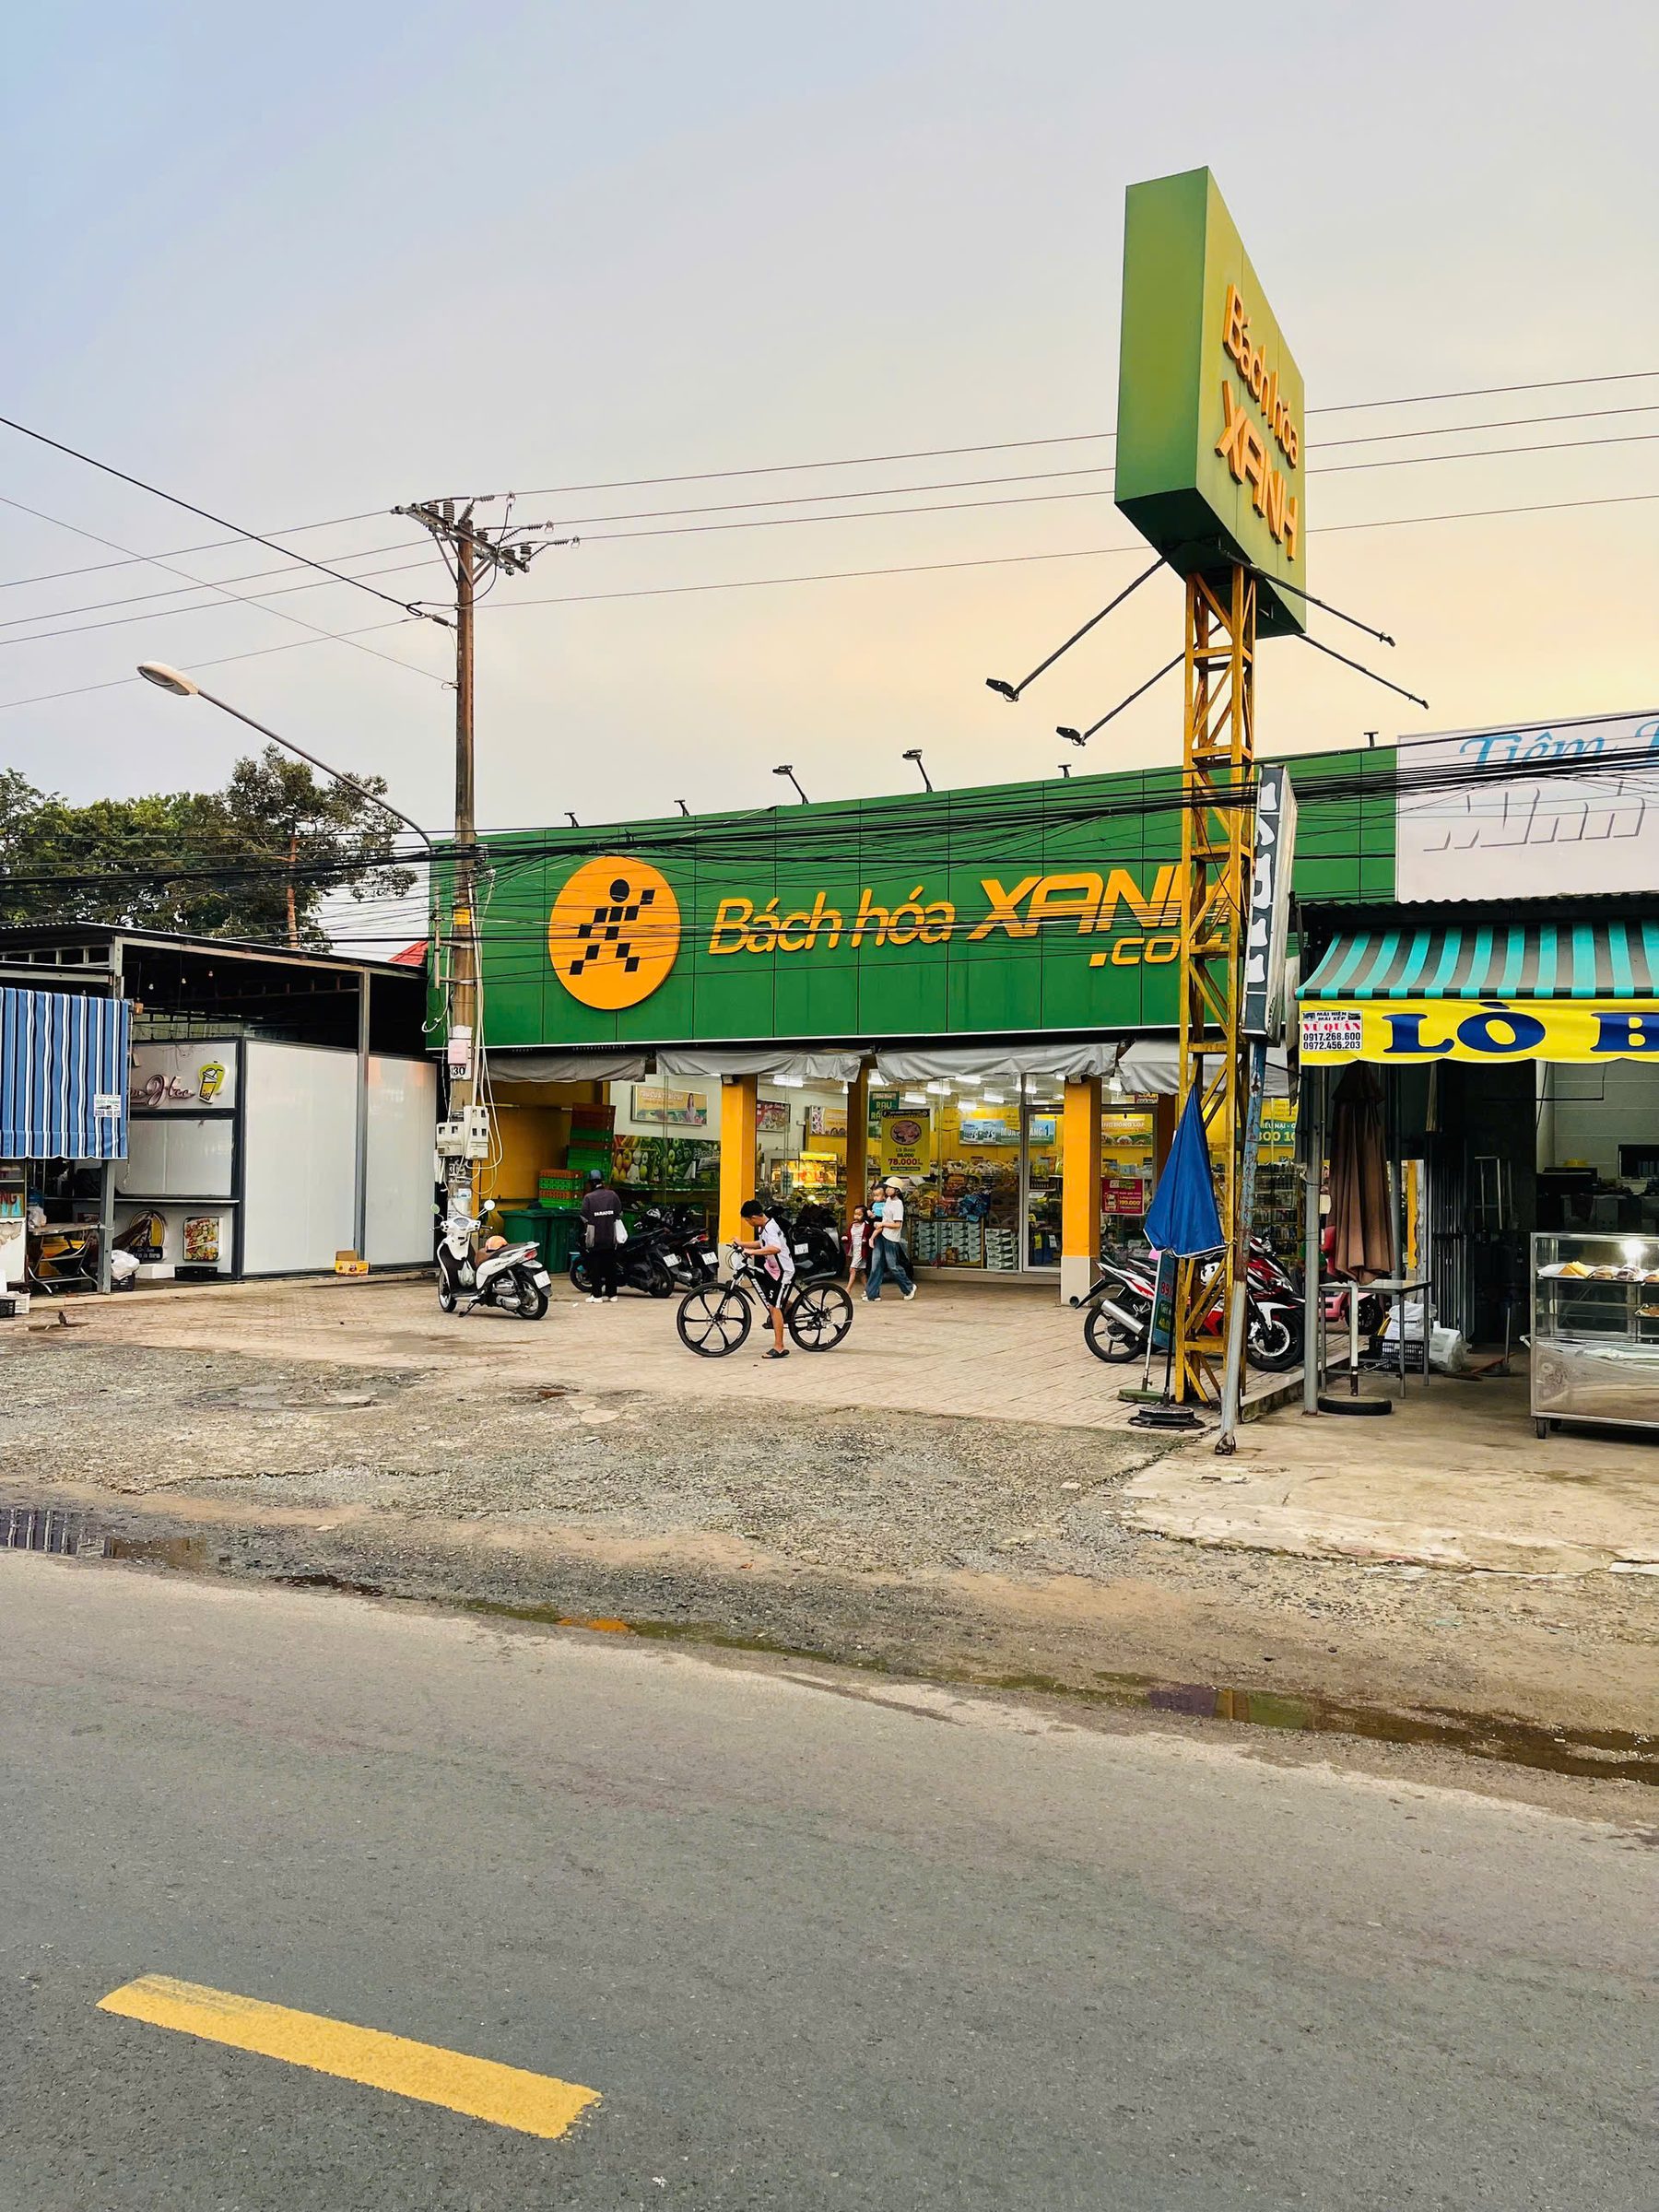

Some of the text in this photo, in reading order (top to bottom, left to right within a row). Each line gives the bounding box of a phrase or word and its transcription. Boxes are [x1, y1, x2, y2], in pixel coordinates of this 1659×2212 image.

[1223, 283, 1300, 470] Bách hóa
[1215, 380, 1300, 561] XANH
[708, 891, 843, 955] Bách
[851, 885, 956, 948] hóa
[1303, 1032, 1361, 1041] 0917.268.600
[1303, 1041, 1361, 1050] 0972.456.203
